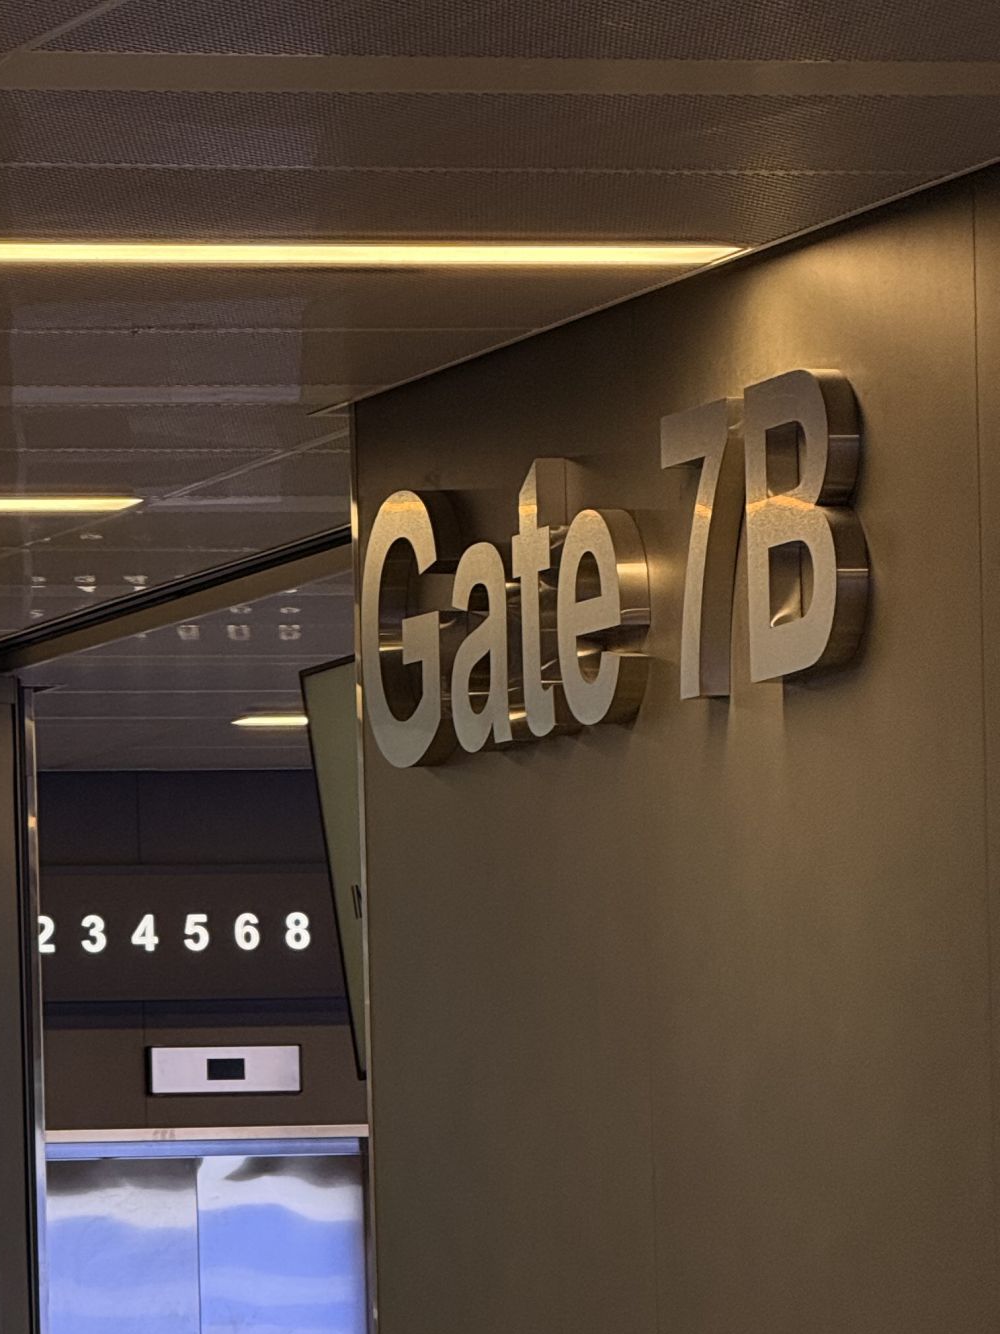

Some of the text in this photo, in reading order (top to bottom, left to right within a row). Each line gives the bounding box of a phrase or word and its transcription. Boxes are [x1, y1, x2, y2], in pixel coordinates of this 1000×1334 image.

[362, 369, 856, 769] Gate 7B
[37, 911, 311, 953] 2 3 4 5 6 8
